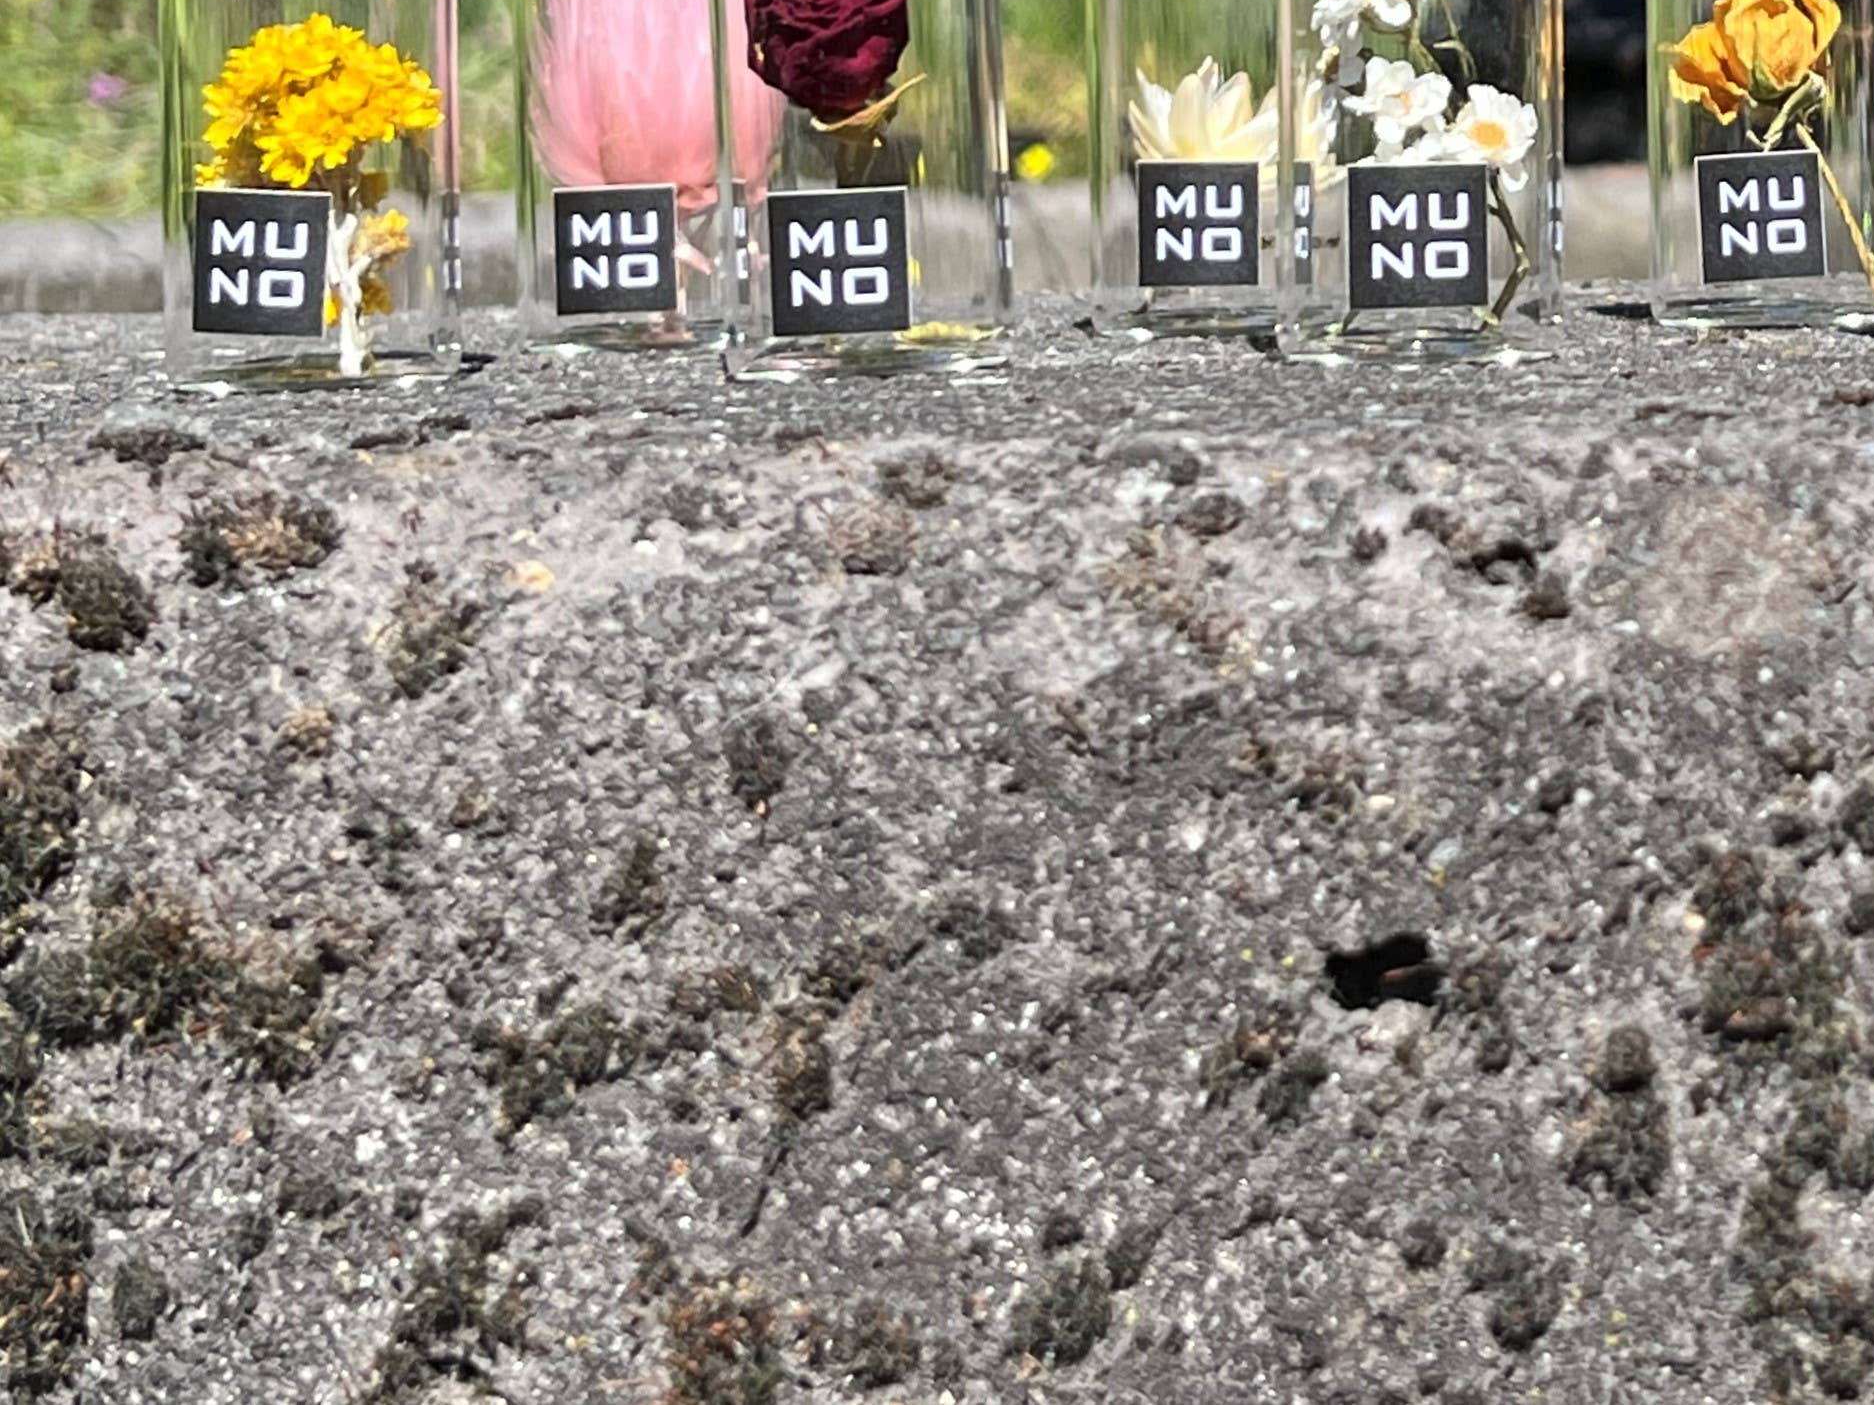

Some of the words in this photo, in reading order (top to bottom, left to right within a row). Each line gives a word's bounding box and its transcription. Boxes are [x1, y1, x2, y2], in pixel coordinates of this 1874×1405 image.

[1155, 184, 1243, 220] MU
[1370, 192, 1470, 231] MU
[1718, 175, 1806, 214] MU
[211, 219, 309, 261] MU
[570, 210, 659, 248] MU
[788, 217, 889, 259] MU
[1155, 227, 1242, 262] NO
[1720, 218, 1808, 257] NO
[572, 253, 660, 290] NO
[1371, 240, 1470, 280] NO
[209, 267, 306, 309] NO
[790, 266, 890, 307] NO
